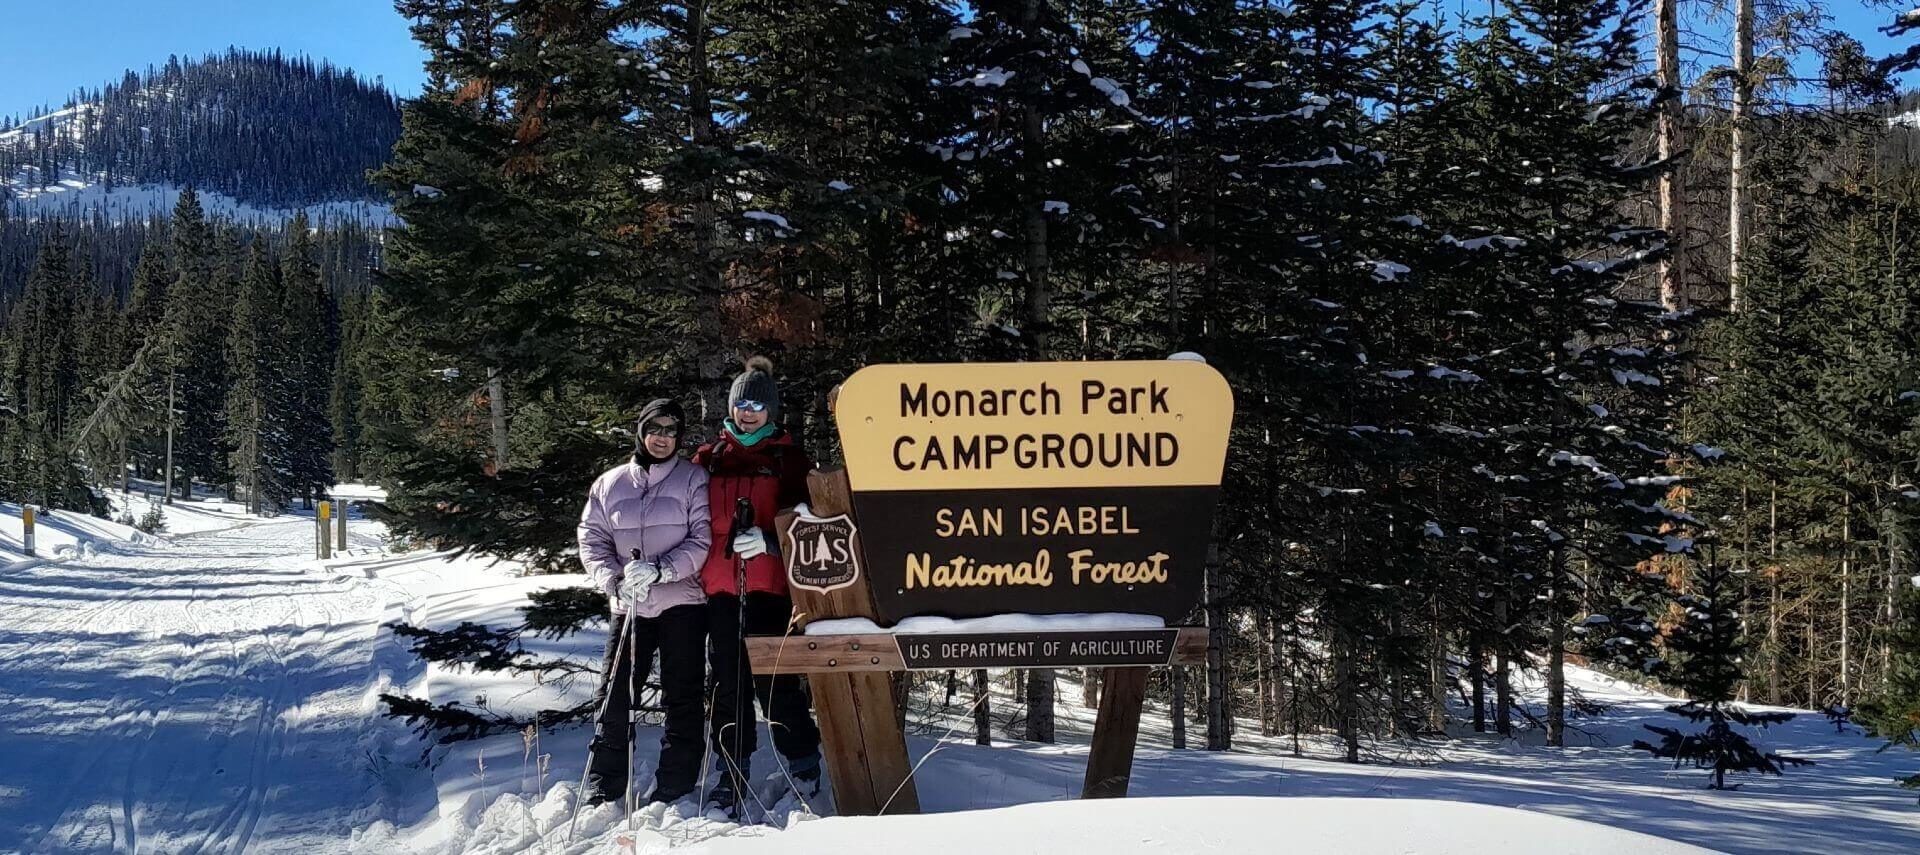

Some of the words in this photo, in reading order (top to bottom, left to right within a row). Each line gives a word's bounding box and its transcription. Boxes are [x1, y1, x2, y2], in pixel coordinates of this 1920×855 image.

[900, 380, 1061, 418] Monarch
[1081, 379, 1170, 415] Park
[892, 432, 1179, 472] CAMPGROUND
[935, 508, 1003, 537] SAN
[1021, 506, 1140, 536] ISABEL
[905, 548, 1054, 589] National
[1067, 549, 1170, 585] Forest
[941, 641, 1035, 659] DEPARTMENT
[1043, 641, 1061, 657] OF
[1070, 639, 1164, 656] AGRICULTURE
